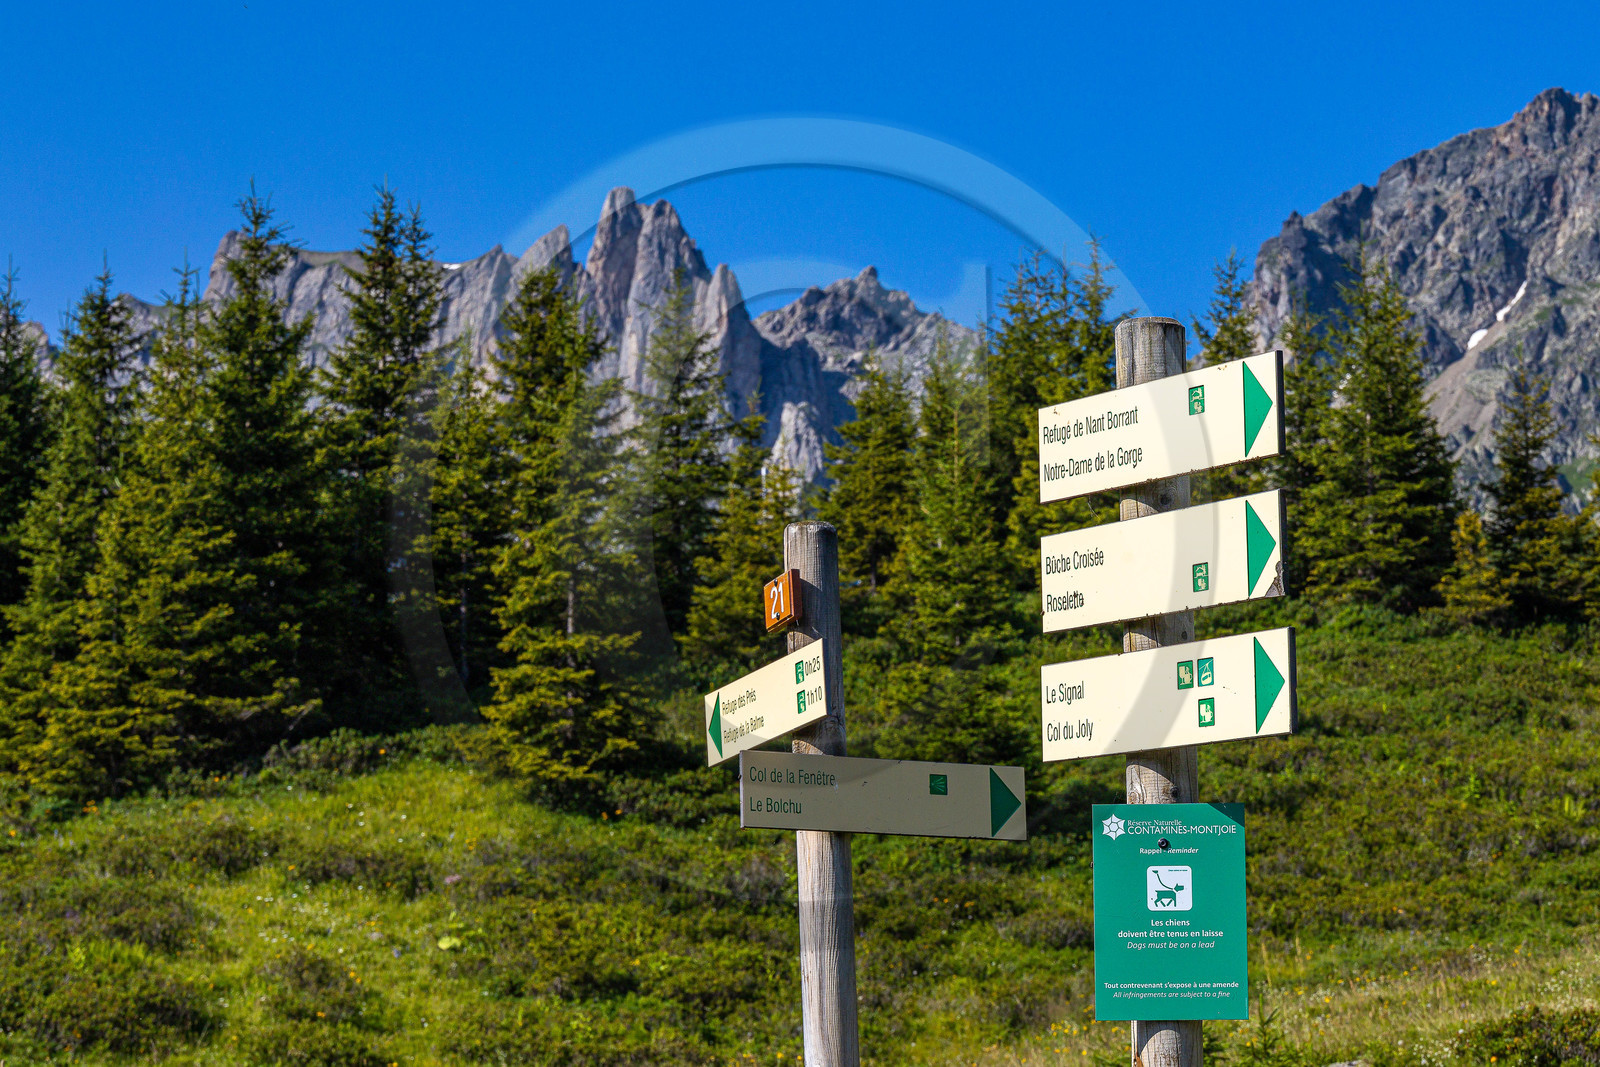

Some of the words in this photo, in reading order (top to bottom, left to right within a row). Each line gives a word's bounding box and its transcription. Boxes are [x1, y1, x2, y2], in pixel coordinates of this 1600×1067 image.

[1043, 424, 1071, 445] Refuge
[1074, 419, 1084, 437] de
[1086, 414, 1105, 435] Nant
[1108, 406, 1138, 430] Borrant
[1044, 458, 1092, 482] Notre-Dame
[1095, 452, 1104, 471] de
[1108, 450, 1115, 468] la
[1118, 447, 1142, 469] Gorge
[1046, 554, 1070, 575] Bûche
[1073, 547, 1104, 570] Croisée
[770, 582, 784, 619] 21
[1047, 590, 1084, 612] Roselette
[805, 656, 821, 676] 0h25
[807, 686, 822, 706] 1h10
[1046, 686, 1056, 704] Le
[1059, 681, 1084, 705] Signal
[722, 698, 737, 716] Refuge
[724, 726, 738, 744] Refuge
[739, 723, 745, 738] de
[745, 721, 749, 734] la
[750, 716, 764, 732] Balme
[1047, 722, 1060, 742] Col
[1063, 721, 1073, 740] du
[1076, 718, 1093, 741] Joly
[750, 766, 767, 782] Col
[770, 768, 782, 782] de
[786, 769, 795, 784] la
[799, 770, 835, 786] Fenêtre
[750, 797, 762, 812] Le
[766, 798, 802, 814] Bolchu
[1128, 825, 1236, 836] CONTAMINES-MONTJOIE
[1127, 941, 1146, 950] Dogs
